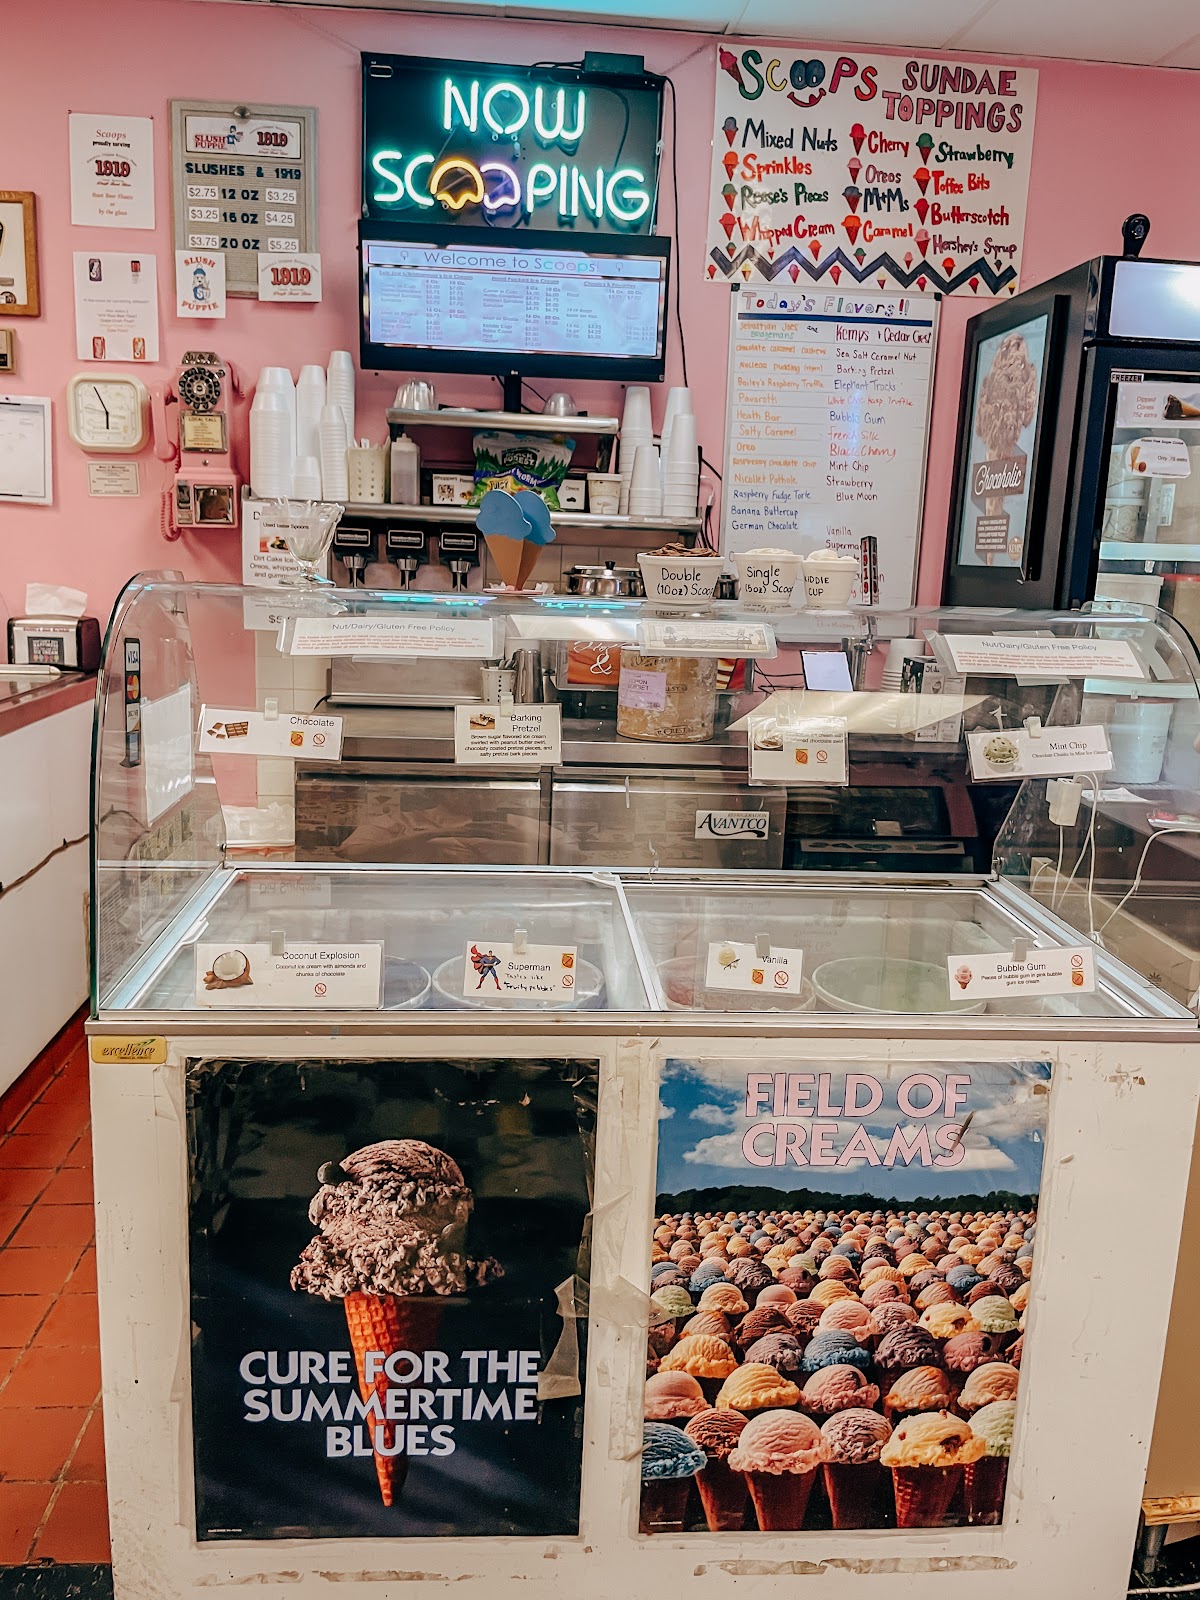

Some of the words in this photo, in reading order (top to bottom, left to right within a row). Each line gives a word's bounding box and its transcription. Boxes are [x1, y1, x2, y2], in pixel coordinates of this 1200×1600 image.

[738, 49, 878, 102] SCOOPS
[902, 60, 1017, 96] SUNDAE
[443, 78, 586, 141] NOW
[882, 90, 1023, 133] TOPPINGS
[96, 129, 127, 140] Scoops
[194, 134, 226, 143] SLUSH
[257, 132, 288, 147] 1919
[742, 118, 794, 148] Mixed
[802, 126, 838, 152] Nuts
[868, 130, 909, 158] Cherry
[934, 141, 1014, 169] Strawberry
[95, 160, 130, 177] 1919
[185, 162, 245, 176] SLUSHES
[256, 166, 264, 178] &
[274, 168, 302, 180] 1919
[740, 153, 812, 182] Sprinkles
[865, 164, 902, 184] Oreos
[372, 150, 650, 221] SCOOPING
[932, 170, 964, 196] Toffee
[968, 172, 990, 191] Bits
[189, 188, 216, 198] $2.75
[222, 188, 236, 200] 12
[240, 190, 259, 200] OZ
[268, 190, 295, 202] $3.25
[794, 182, 829, 206] Pieces
[190, 209, 218, 220] $3.25
[222, 212, 237, 222] 16
[241, 213, 258, 224] OZ
[266, 213, 293, 224] $4.25
[930, 202, 1010, 226] Butterscotch
[794, 214, 835, 238] Cream
[863, 220, 914, 242] Caramel
[190, 236, 218, 246] $3.75
[220, 238, 238, 248] 20
[242, 238, 260, 250] OZ
[270, 241, 297, 250] $5.25
[932, 234, 978, 256] Hershey's
[984, 237, 1018, 260] Syrup
[183, 256, 216, 268] SLUSH
[424, 252, 506, 268] Welcome
[513, 256, 529, 268] to
[534, 258, 600, 272] Scoops!
[270, 267, 311, 286] 1919
[181, 300, 219, 311] PUPPIE
[742, 292, 816, 312] Today's
[836, 348, 850, 358] Sea
[904, 352, 916, 362] Nut
[870, 366, 894, 376] Pretzel
[1112, 374, 1142, 382] FREEZER
[764, 412, 780, 421] Bar
[864, 412, 886, 424] Gum
[764, 426, 796, 436] Caramel
[736, 442, 756, 451] Oreo
[830, 460, 848, 472] Mint
[852, 460, 869, 473] Chip
[826, 475, 874, 490] Strawberry
[974, 462, 1022, 496] Chocoholic
[734, 489, 768, 500] Raspberry
[772, 490, 792, 503] Fudge
[794, 490, 811, 500] Torte
[836, 492, 854, 502] Blue
[856, 492, 878, 501] Moon
[730, 504, 760, 516] Banana
[764, 506, 798, 520] Buttercup
[732, 520, 764, 530] German
[768, 521, 798, 530] Chocolate
[826, 526, 852, 536] Vanilla
[825, 540, 861, 551] Superma
[662, 566, 702, 582] Double
[746, 566, 780, 586] Single
[657, 584, 688, 596] (10oz)
[745, 583, 766, 594] (5oz)
[808, 588, 824, 596] CUP
[128, 652, 139, 664] VISA
[290, 716, 335, 727] Chocolate
[510, 714, 542, 723] Barking
[512, 724, 540, 732] Pretzel
[1049, 742, 1068, 751] Mint
[1068, 741, 1088, 750] Chip
[698, 813, 767, 833] AVANTCO
[282, 952, 317, 960] Coconut
[320, 952, 360, 961] Explosion
[762, 956, 788, 964] Vanilla
[508, 962, 550, 972] Superman
[996, 964, 1024, 972] Bubble
[1027, 963, 1046, 971] Gum
[103, 1044, 156, 1056] excellence
[745, 1072, 884, 1118] FIELD
[896, 1072, 972, 1119] OF
[742, 1121, 966, 1168] CREAMS
[239, 1350, 352, 1385] CURE
[364, 1350, 450, 1384] FOR
[460, 1350, 542, 1384] THE
[244, 1388, 538, 1422] SUMMERTIME
[326, 1424, 456, 1457] BLUES
